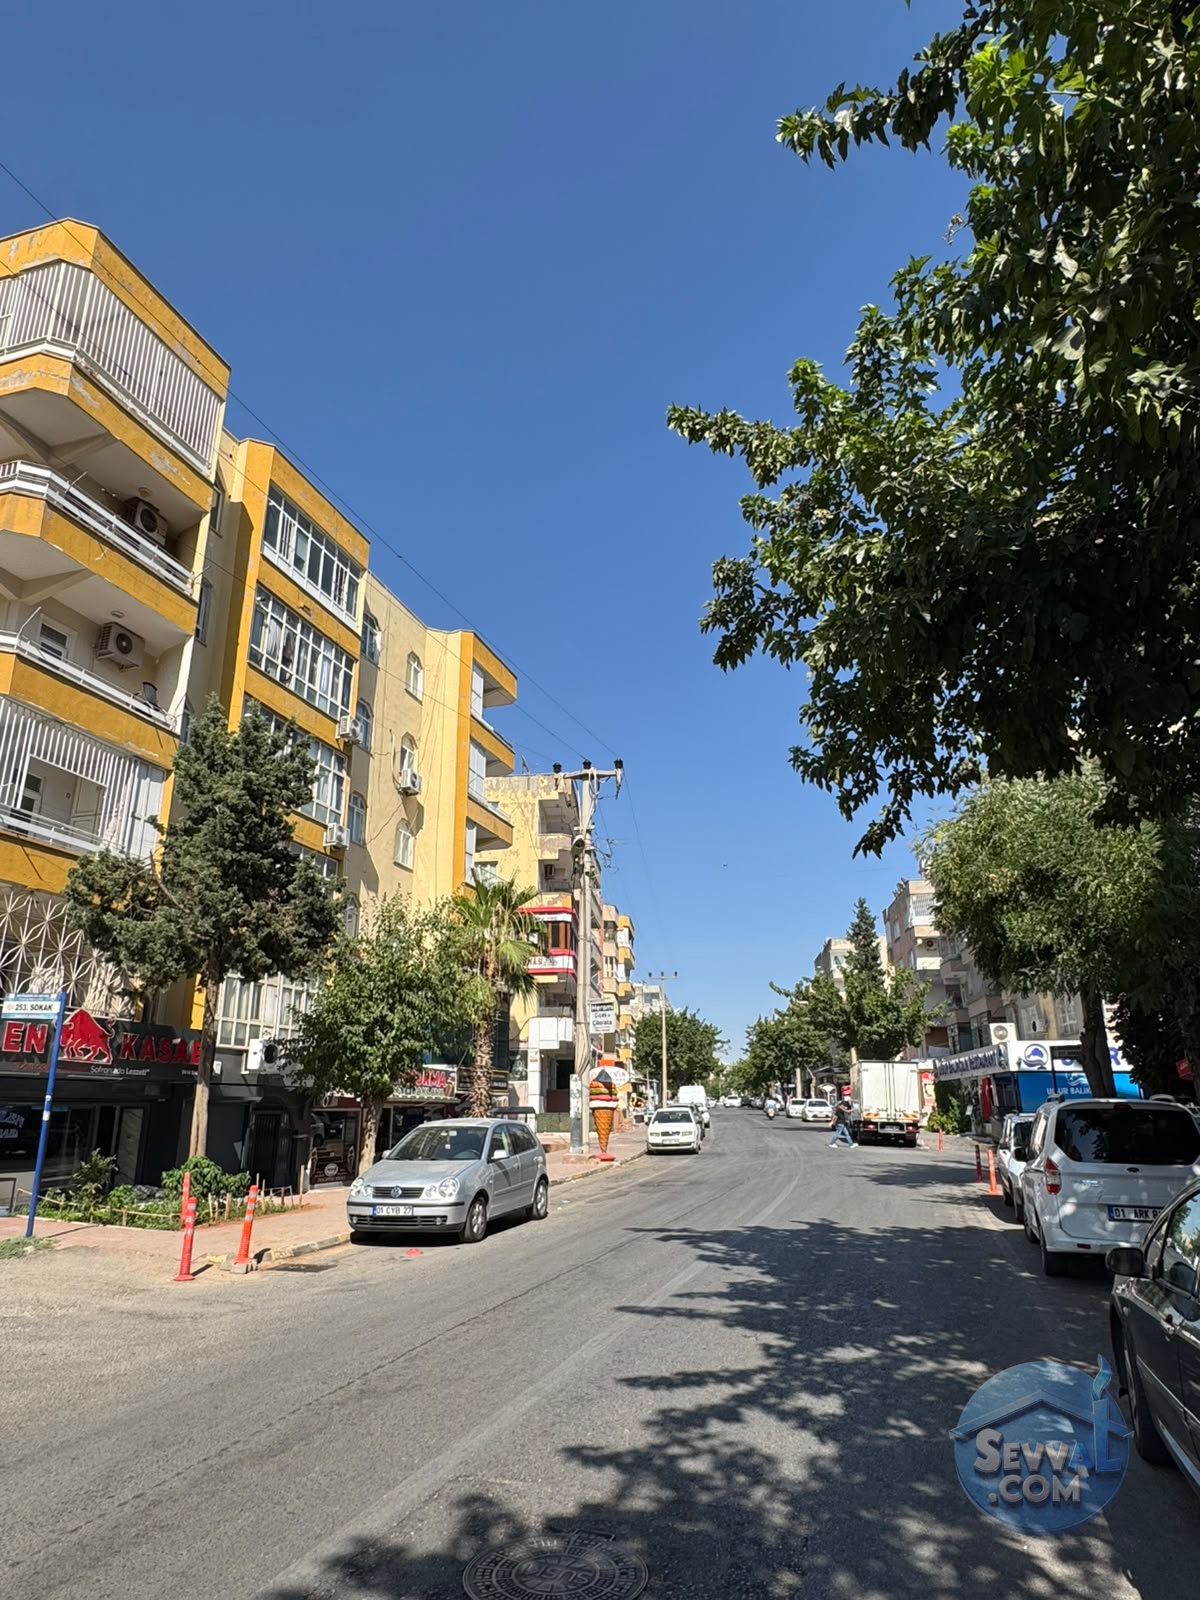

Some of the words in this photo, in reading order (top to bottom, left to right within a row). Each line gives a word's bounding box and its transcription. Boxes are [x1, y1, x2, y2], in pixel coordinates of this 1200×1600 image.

[376, 1205, 383, 1214] 01
[1114, 1208, 1126, 1217] 01
[1133, 1209, 1150, 1219] ARK
